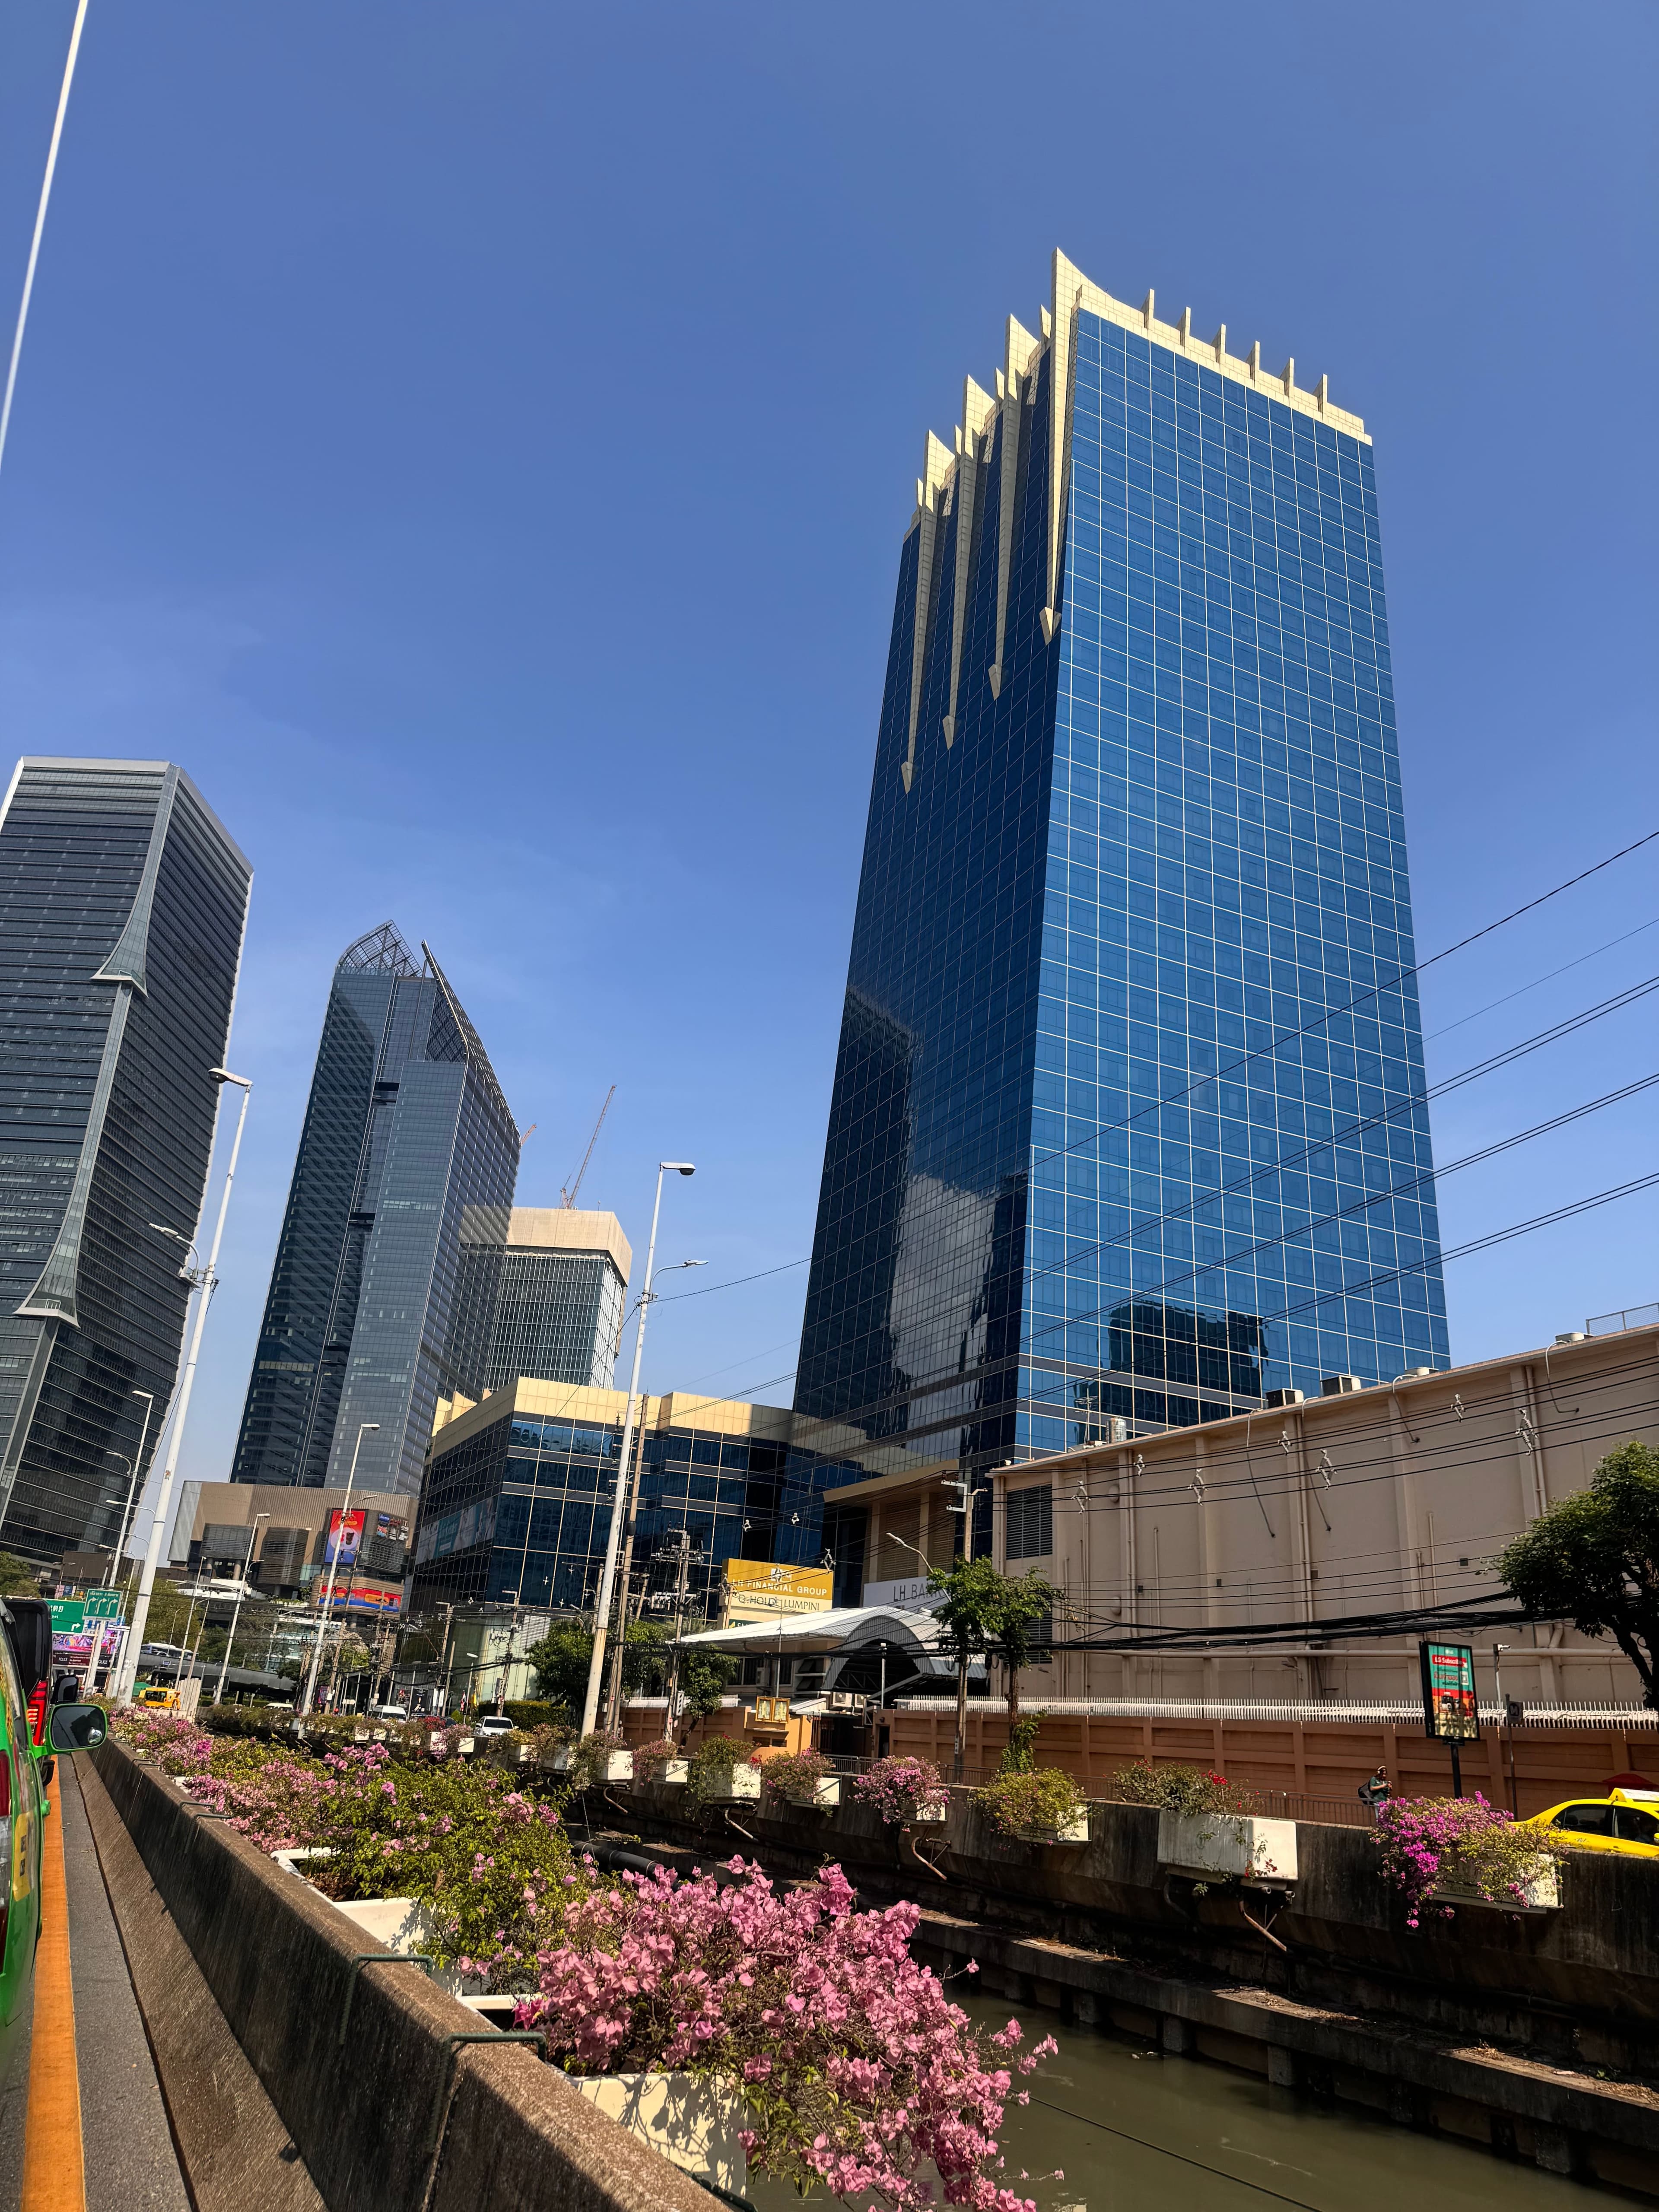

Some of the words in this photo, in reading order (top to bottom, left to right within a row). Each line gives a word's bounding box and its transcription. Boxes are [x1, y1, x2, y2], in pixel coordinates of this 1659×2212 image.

[747, 1581, 793, 1592] FINANCIAL
[797, 1586, 827, 1596] GROUP
[893, 1585, 906, 1602] LH
[784, 1600, 820, 1611] LUMPINI
